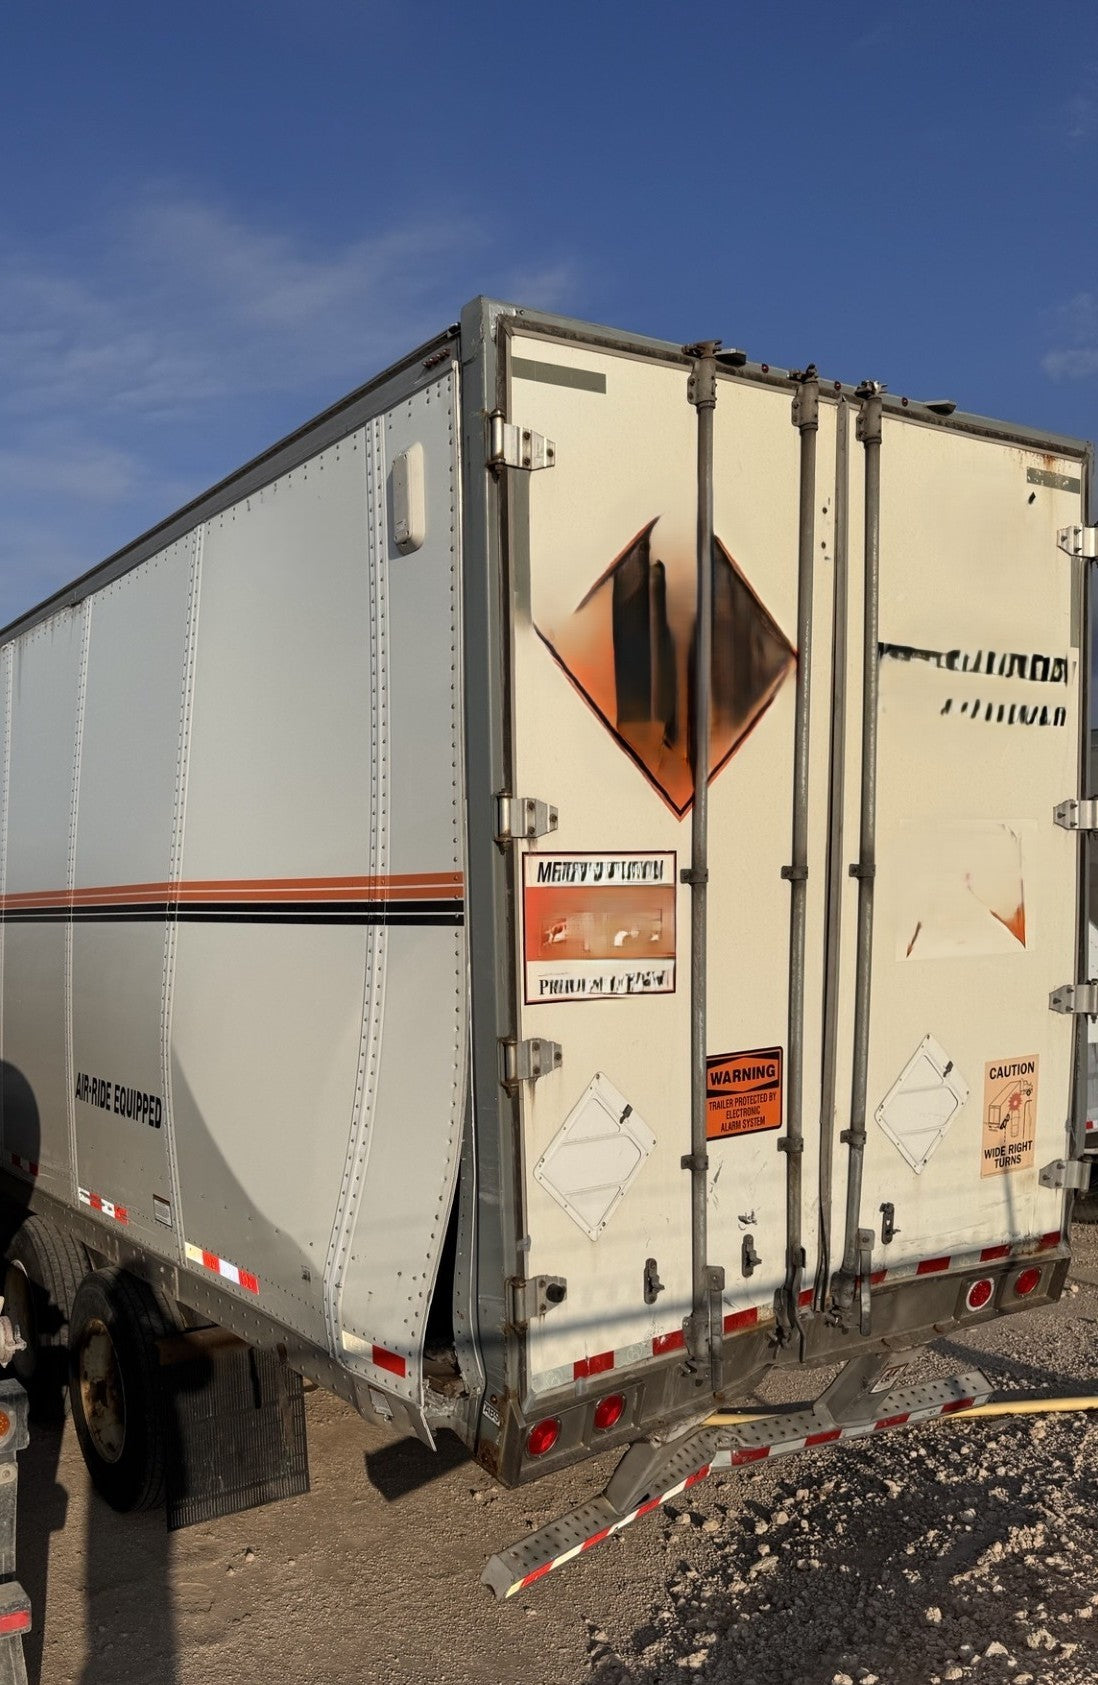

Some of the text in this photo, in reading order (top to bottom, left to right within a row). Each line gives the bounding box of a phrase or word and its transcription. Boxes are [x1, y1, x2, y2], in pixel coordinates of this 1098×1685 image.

[710, 1064, 776, 1086] WARNING
[989, 1061, 1035, 1080] CAUTION
[75, 1072, 162, 1129] AIR-RIDE EQUIPPED
[709, 1091, 777, 1111] TRAILER PROTECTED BY
[726, 1106, 761, 1120] ELECTRONIC
[720, 1116, 766, 1133] ALARM SYSTEM
[984, 1140, 1033, 1159] WIDE RIGHT
[994, 1154, 1022, 1168] TURNS
